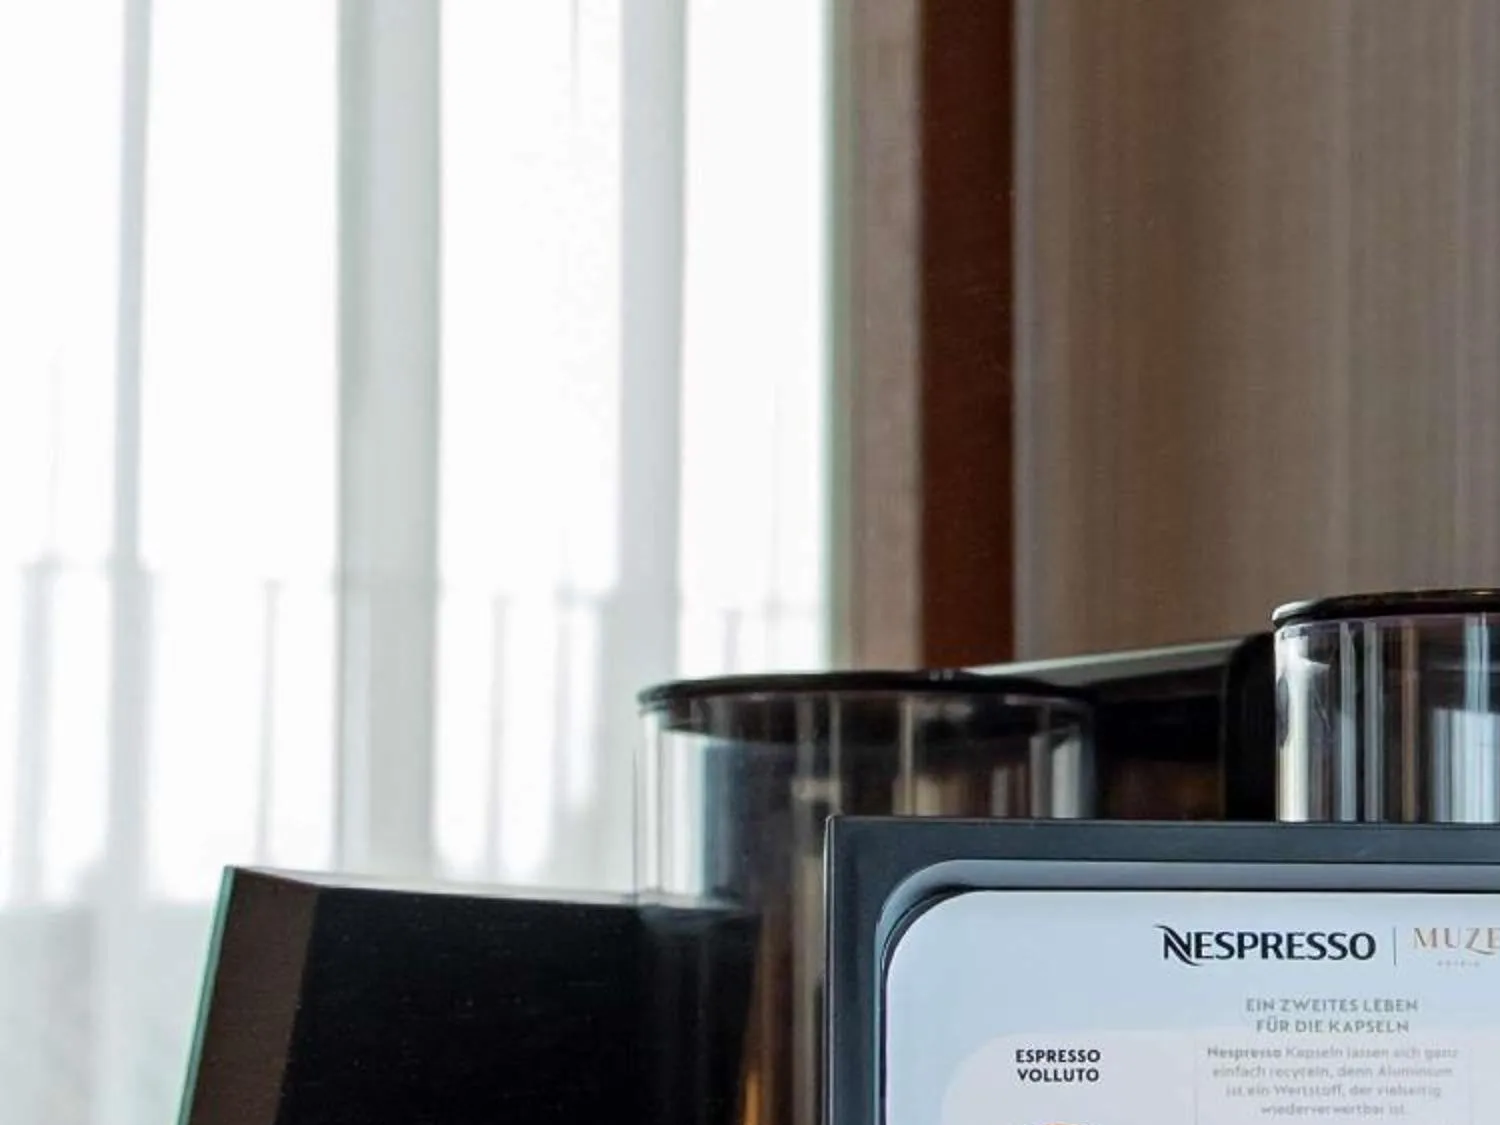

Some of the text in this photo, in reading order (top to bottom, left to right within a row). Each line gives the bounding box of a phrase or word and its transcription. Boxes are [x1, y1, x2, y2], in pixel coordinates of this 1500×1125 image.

[1153, 924, 1376, 966] NESPRESSO
[1245, 998, 1419, 1013] EIN ZWEITES LEBEN
[1256, 1017, 1410, 1034] FÜR DIE KAPSELN
[1015, 1049, 1101, 1063] ESPRESSO
[1207, 1046, 1282, 1061] Nespresso
[1017, 1068, 1100, 1082] VOLLUTO
